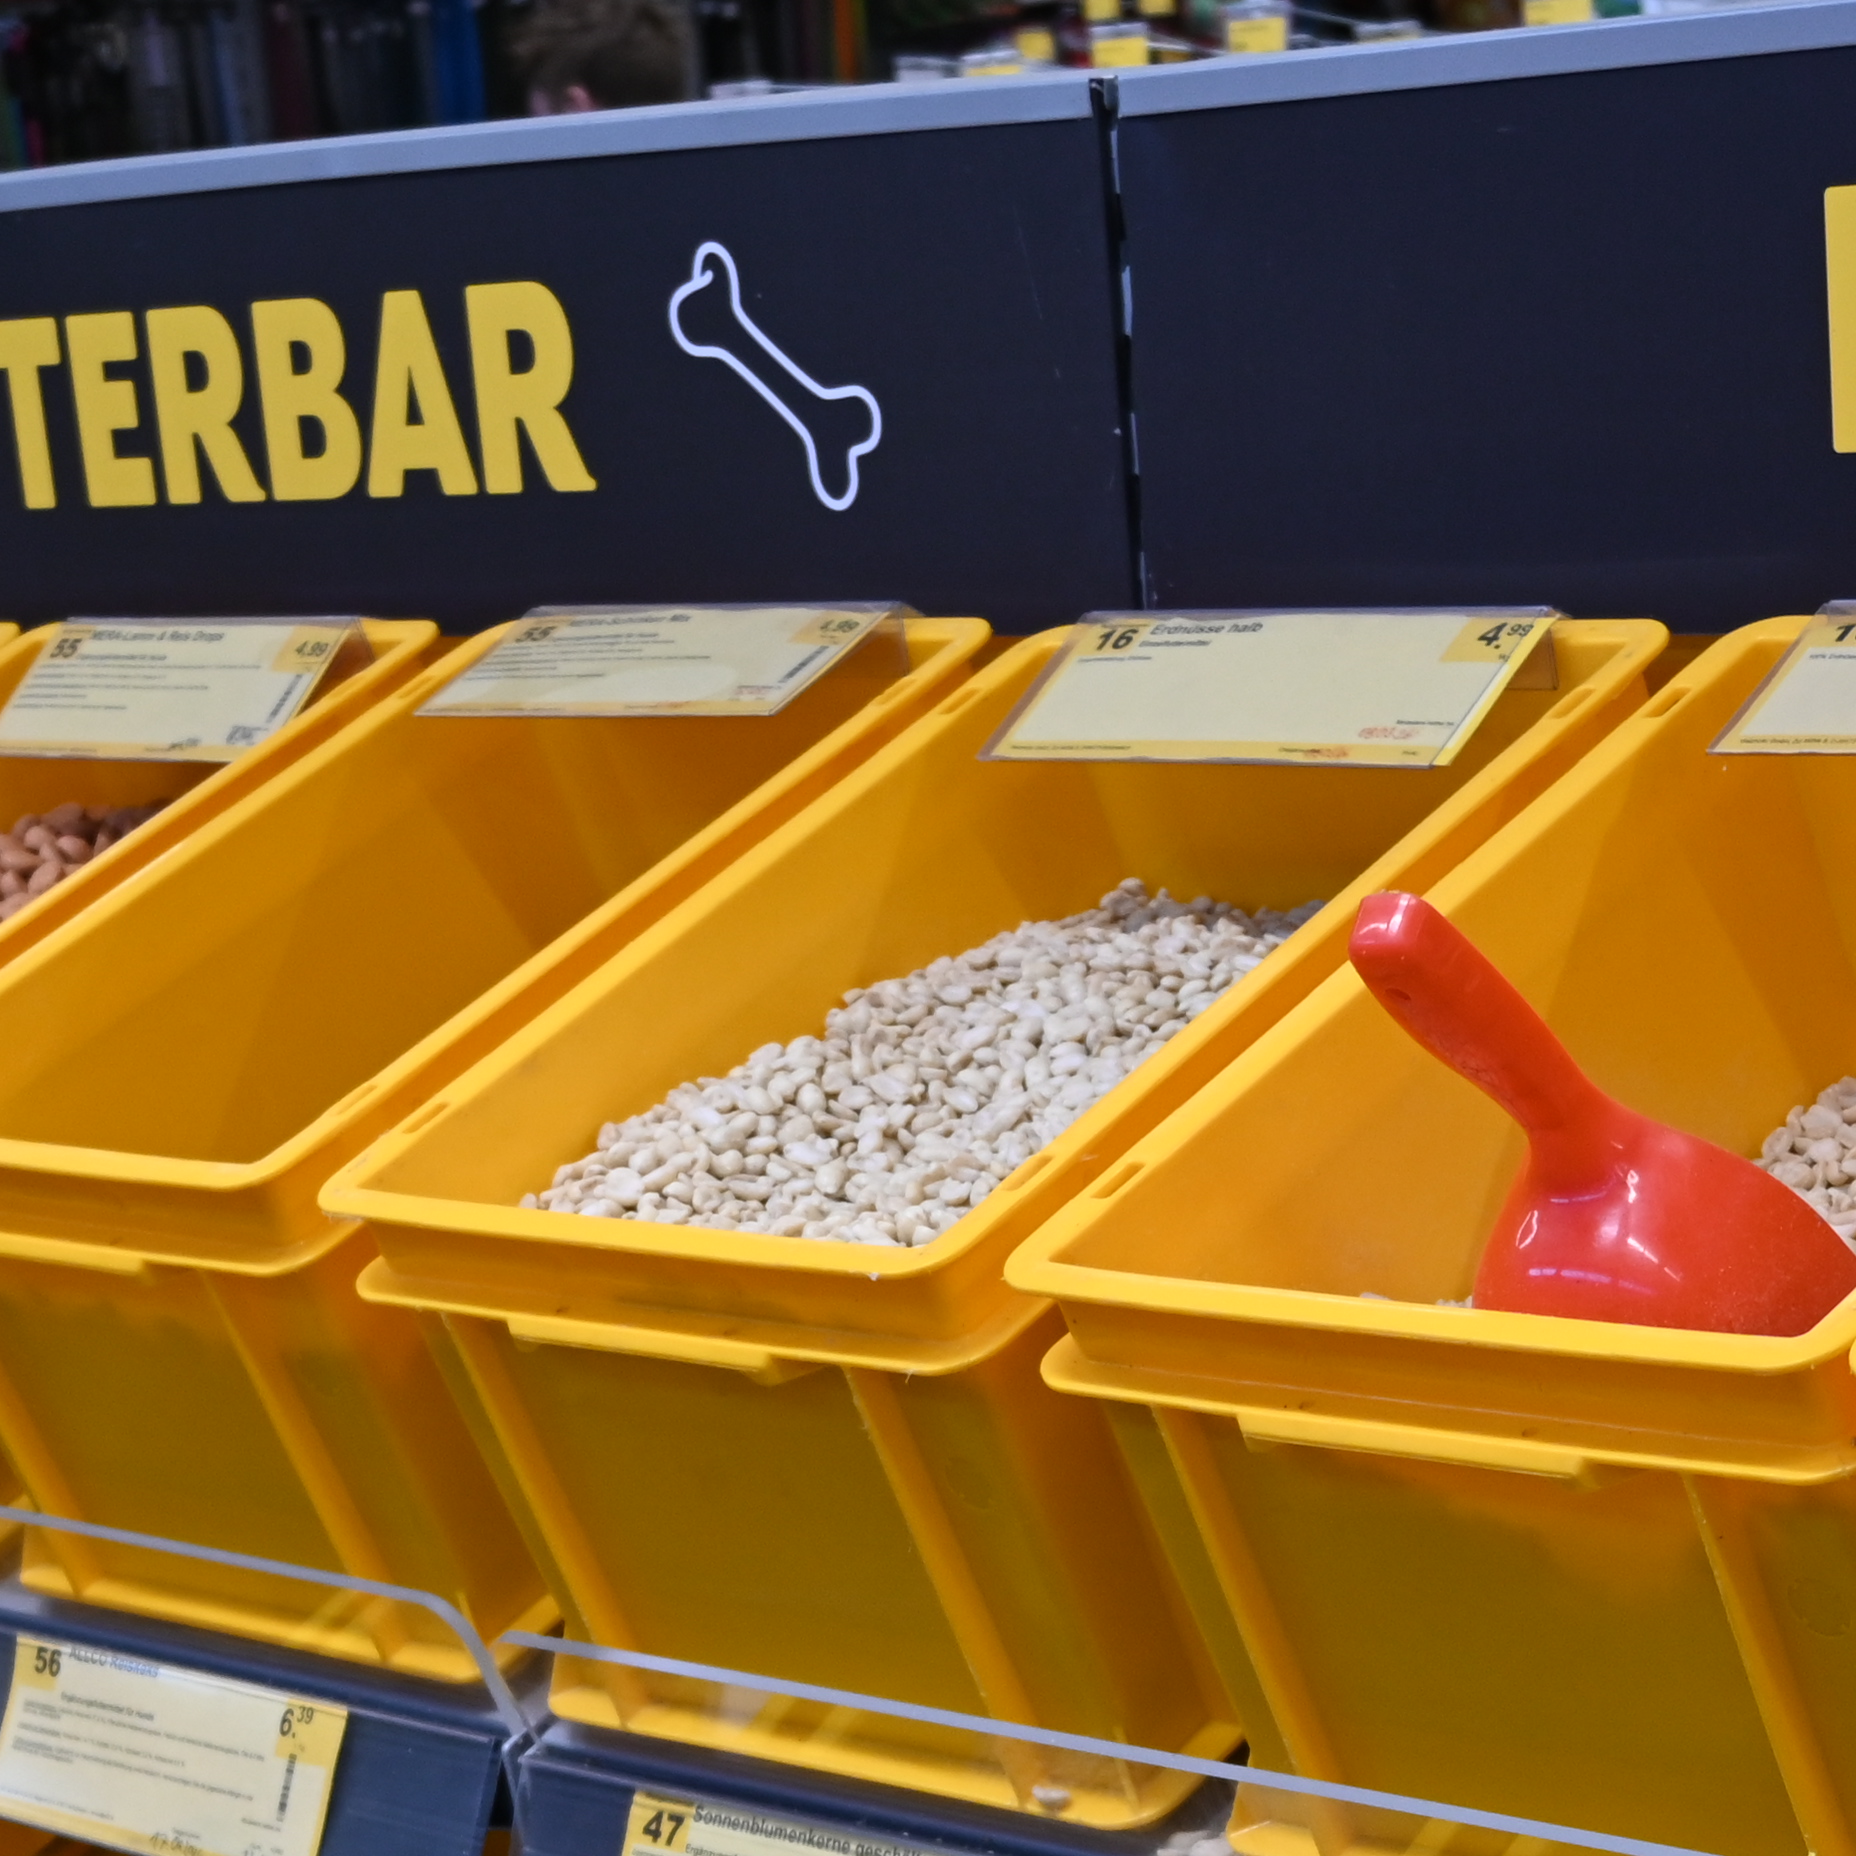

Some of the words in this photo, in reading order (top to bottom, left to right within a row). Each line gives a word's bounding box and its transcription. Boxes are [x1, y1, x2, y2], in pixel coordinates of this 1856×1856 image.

[1096, 628, 1138, 651] 16
[1228, 620, 1263, 633] halb
[1479, 623, 1532, 651] 4.99
[50, 638, 82, 658] 55
[34, 1646, 62, 1678] 56
[279, 1706, 314, 1738] 6.39
[642, 1811, 686, 1846] 47
[692, 1805, 850, 1855] Sonnenblumenkerne
